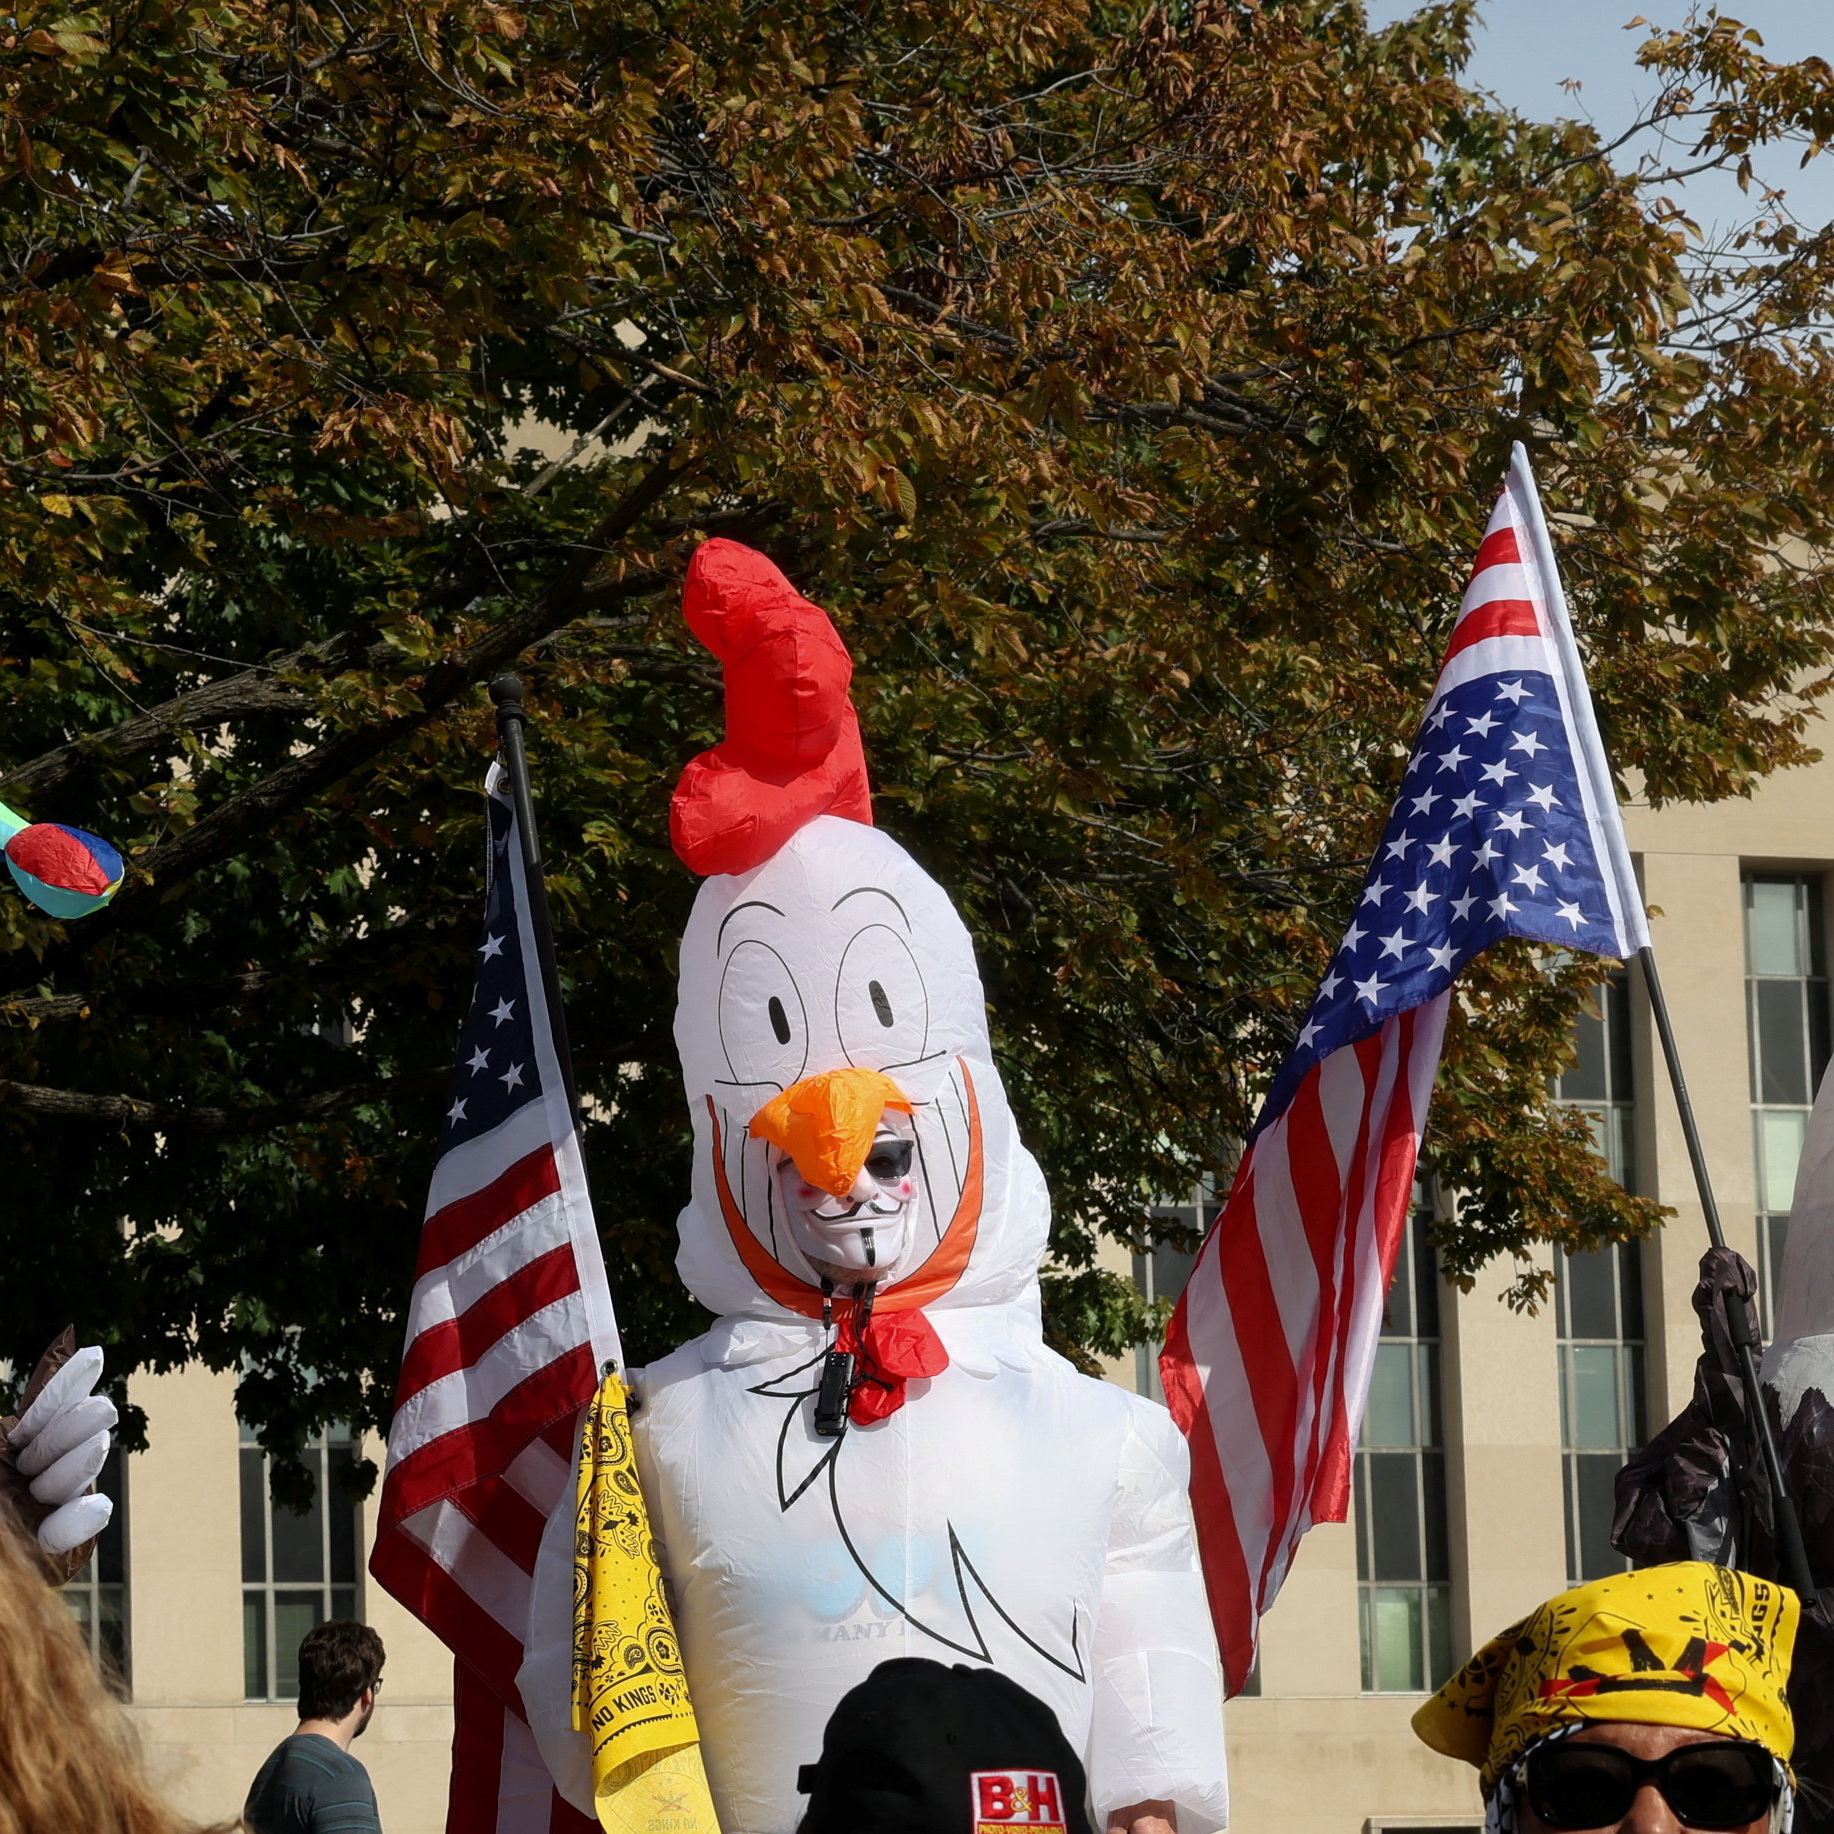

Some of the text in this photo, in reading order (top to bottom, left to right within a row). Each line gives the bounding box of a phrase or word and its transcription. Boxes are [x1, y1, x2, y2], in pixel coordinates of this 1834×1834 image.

[591, 1685, 658, 1732] NO KINGS
[978, 1775, 1061, 1821] B&H
